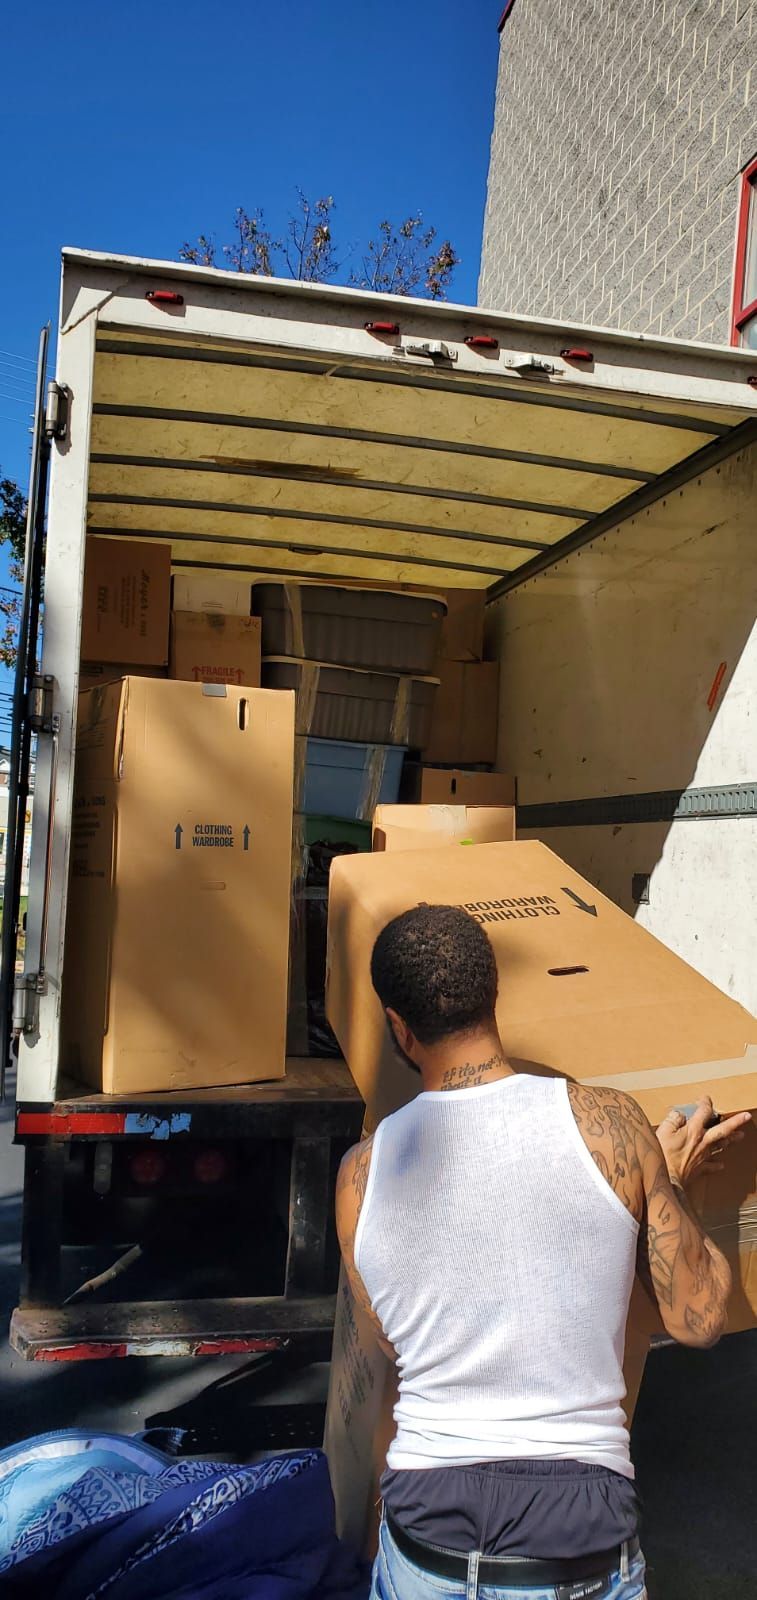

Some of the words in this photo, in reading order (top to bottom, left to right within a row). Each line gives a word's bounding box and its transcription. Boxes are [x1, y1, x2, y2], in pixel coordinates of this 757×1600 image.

[201, 666, 235, 677] FRAGILE
[194, 824, 233, 835] CLOTHING
[192, 836, 235, 848] WARDROBE
[475, 905, 561, 924] CLOTHING
